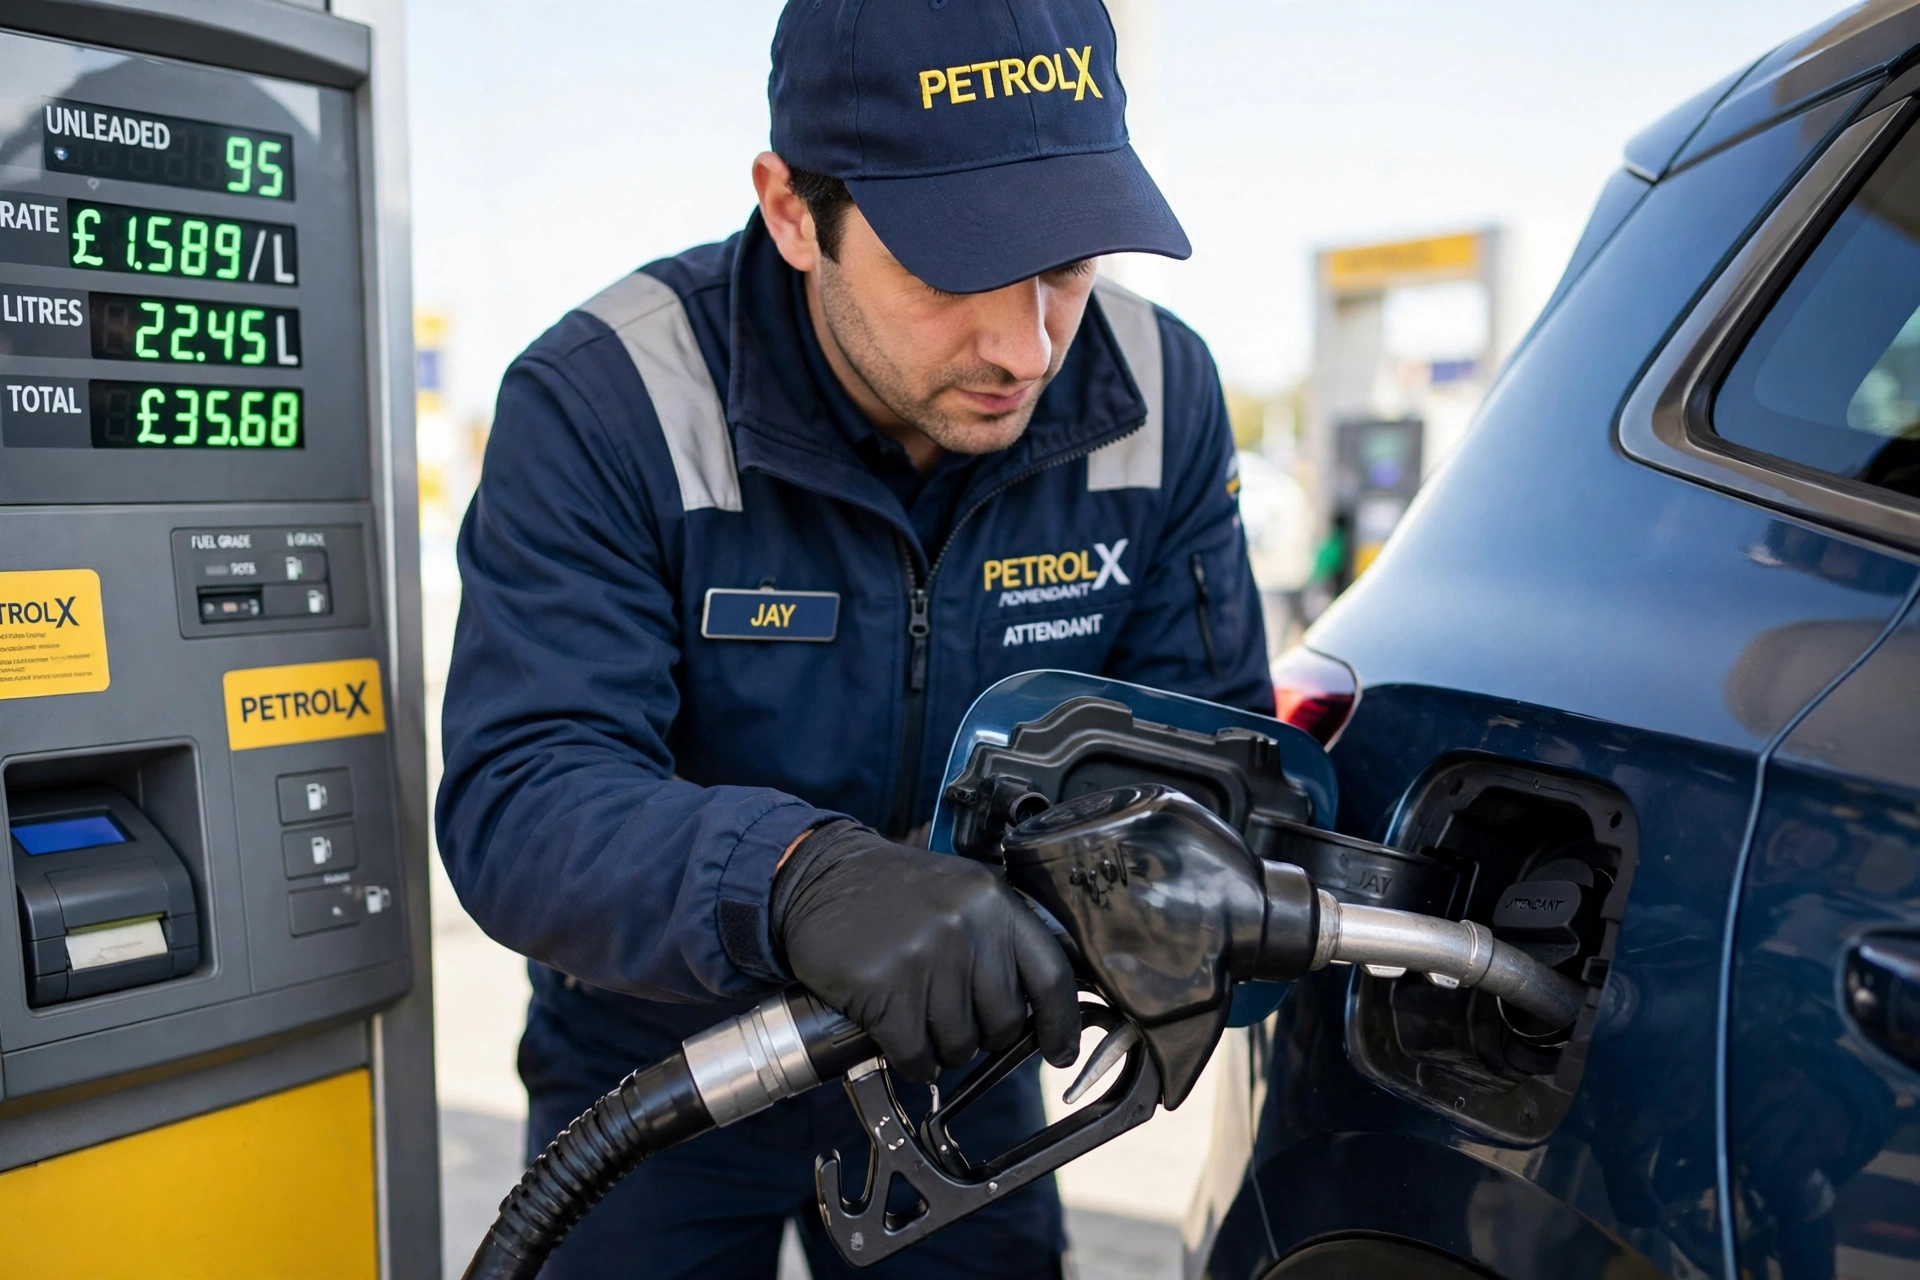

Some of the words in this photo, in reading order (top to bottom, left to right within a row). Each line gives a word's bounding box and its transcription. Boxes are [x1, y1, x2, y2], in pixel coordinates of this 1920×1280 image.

[919, 46, 1103, 109] PETROLX
[46, 105, 171, 150] UNLEADED
[226, 137, 283, 197] 95
[0, 200, 60, 233] RATE
[3, 294, 83, 326] LITRES
[7, 385, 82, 414] TOTAL
[137, 388, 299, 447] £35.68
[191, 535, 217, 549] FUEL
[217, 534, 252, 549] GRADE
[983, 538, 1131, 591] PETROLX
[750, 603, 796, 628] JAY
[1003, 613, 1104, 647] ATTENDANT
[241, 680, 371, 723] PETROLX
